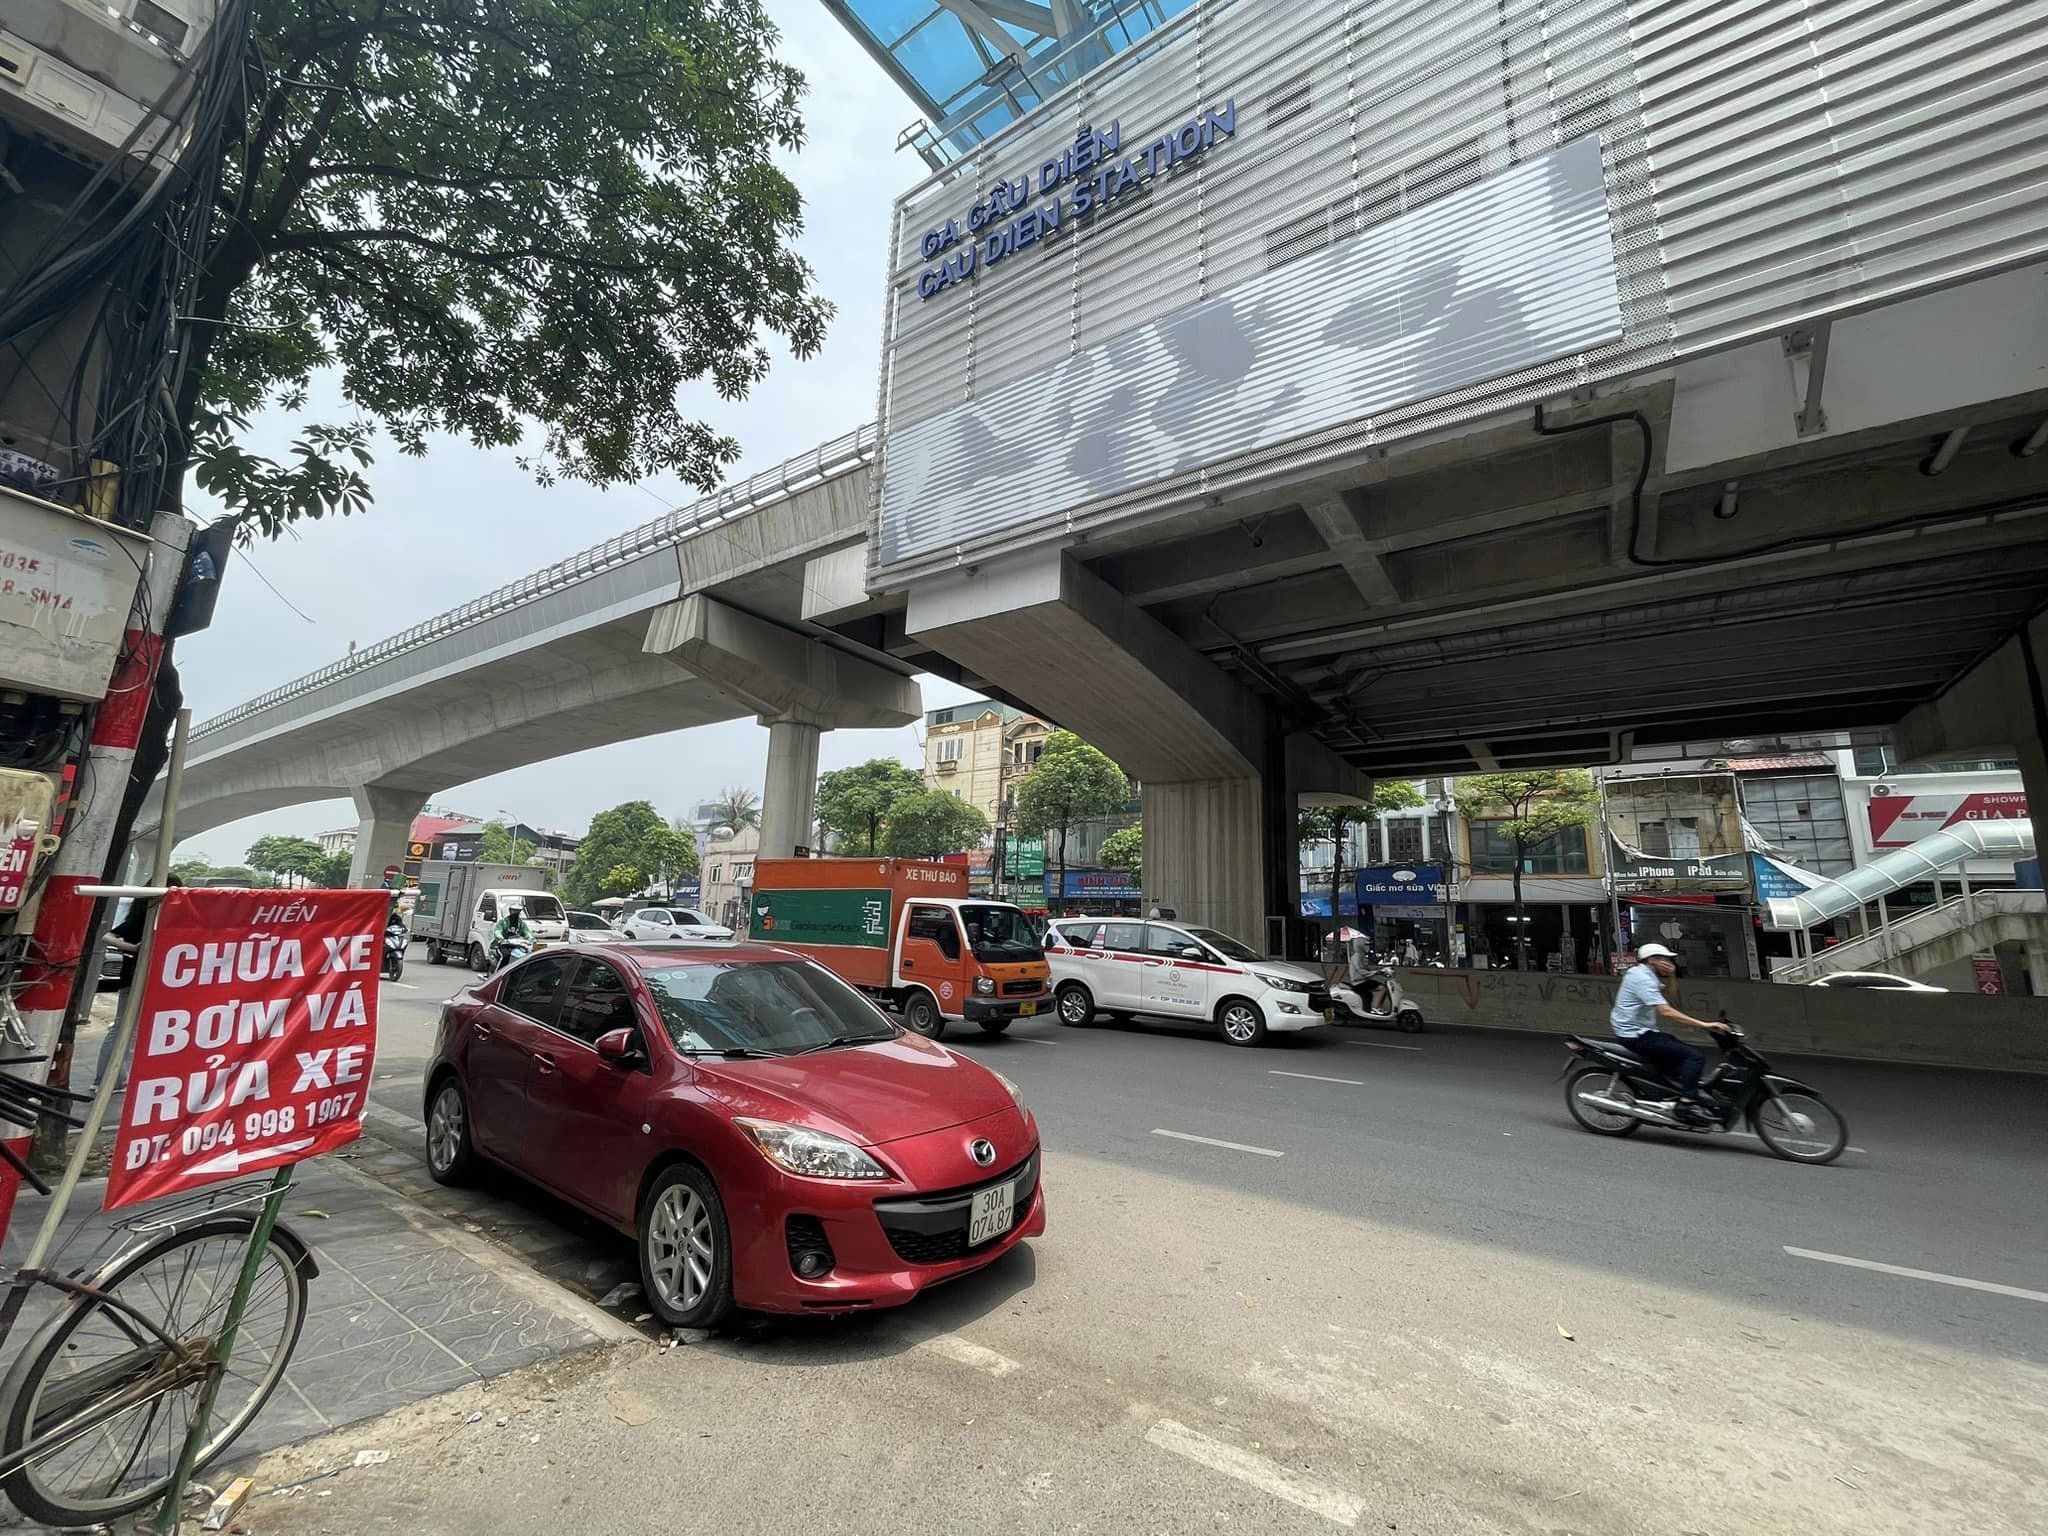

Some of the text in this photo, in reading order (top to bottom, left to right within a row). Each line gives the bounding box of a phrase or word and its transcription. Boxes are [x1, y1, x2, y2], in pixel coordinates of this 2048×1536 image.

[918, 99, 1236, 299] CAU DIEN STATION
[920, 118, 1120, 260] GA CẦU DIỄN
[1965, 809, 2004, 820] GIA
[905, 868, 919, 880] XE
[251, 897, 319, 925] HIỂN
[161, 932, 375, 988] CHỮA XE
[147, 981, 368, 1057] BƠM VÁ
[131, 1044, 367, 1127] RỬA XE
[126, 1092, 357, 1171] ĐT: 094 998 1967
[971, 1206, 1012, 1241] 074.87
[983, 1187, 1005, 1214] 30A
